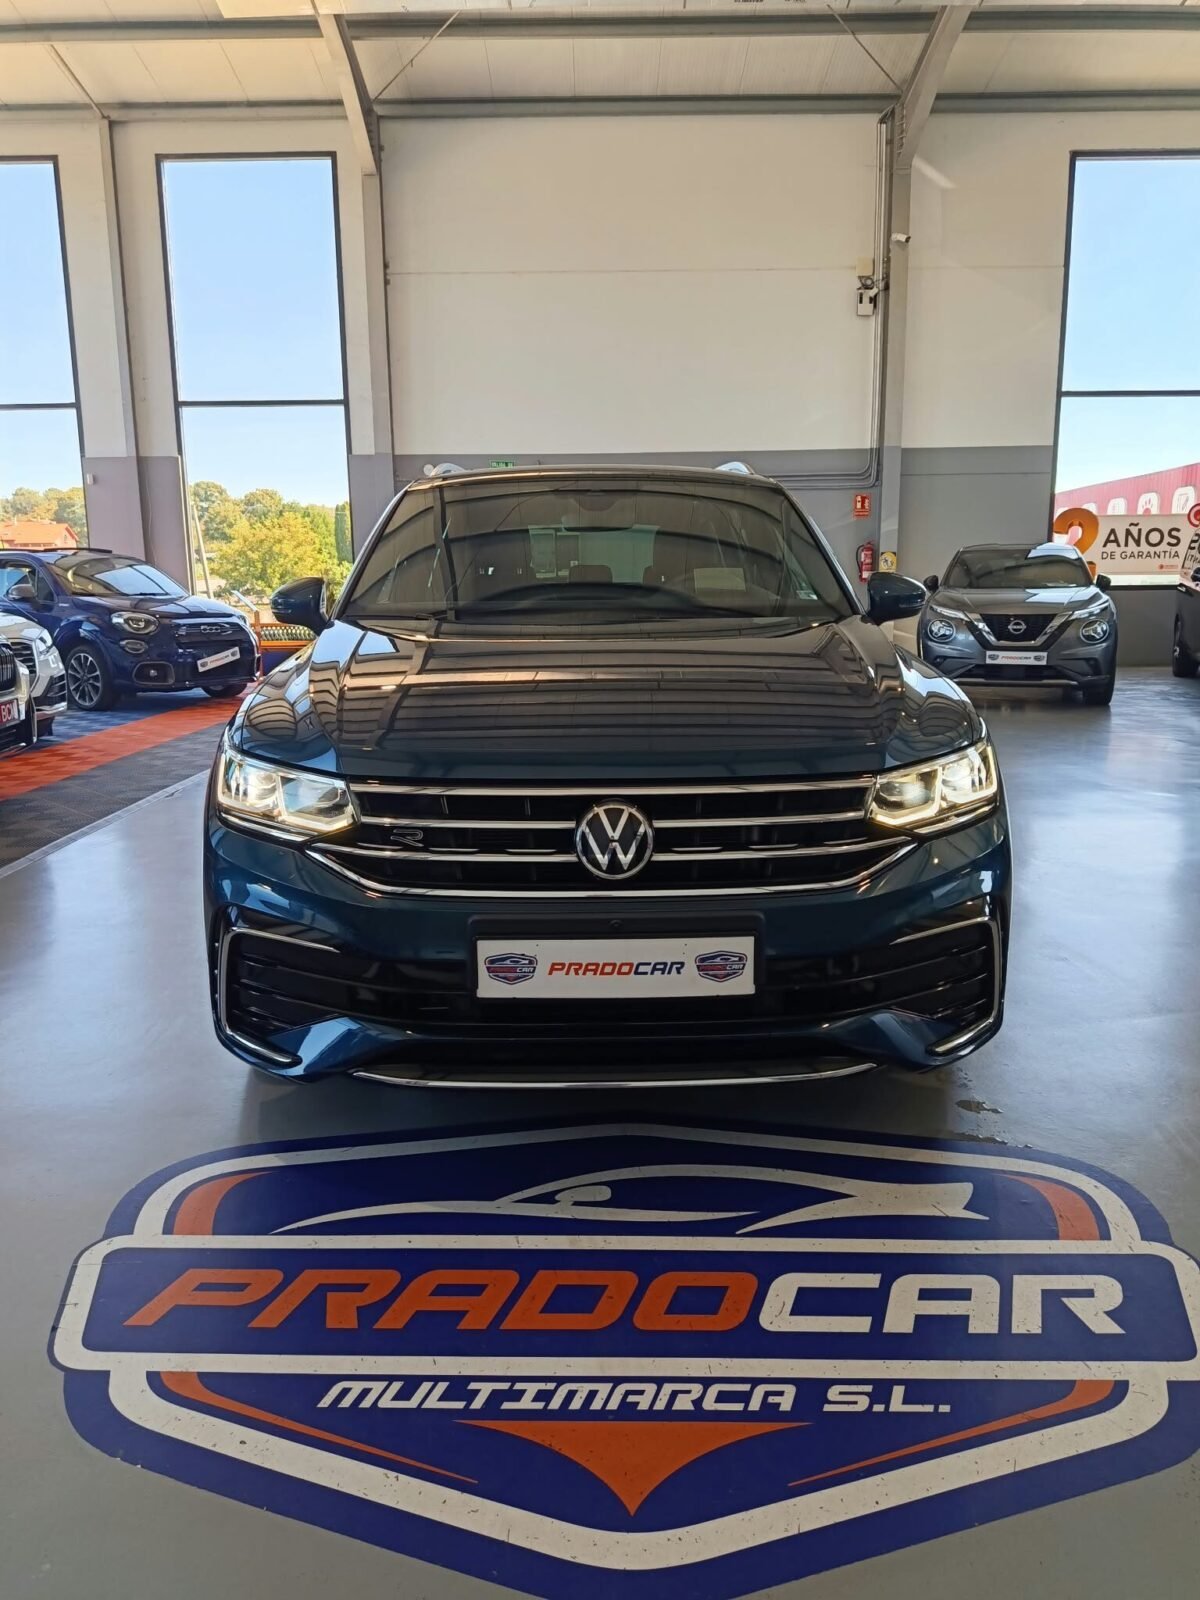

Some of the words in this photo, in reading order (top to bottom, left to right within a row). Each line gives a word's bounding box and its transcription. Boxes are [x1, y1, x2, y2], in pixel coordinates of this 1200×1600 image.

[1102, 522, 1181, 548] AÑOS
[1101, 551, 1117, 560] DE
[1119, 549, 1180, 560] GARANTÍA
[547, 961, 686, 976] PRADOCAR
[122, 1267, 1126, 1334] PRADOCAR
[316, 1380, 797, 1412] MULTIMARCA
[822, 1384, 951, 1412] S.L.
